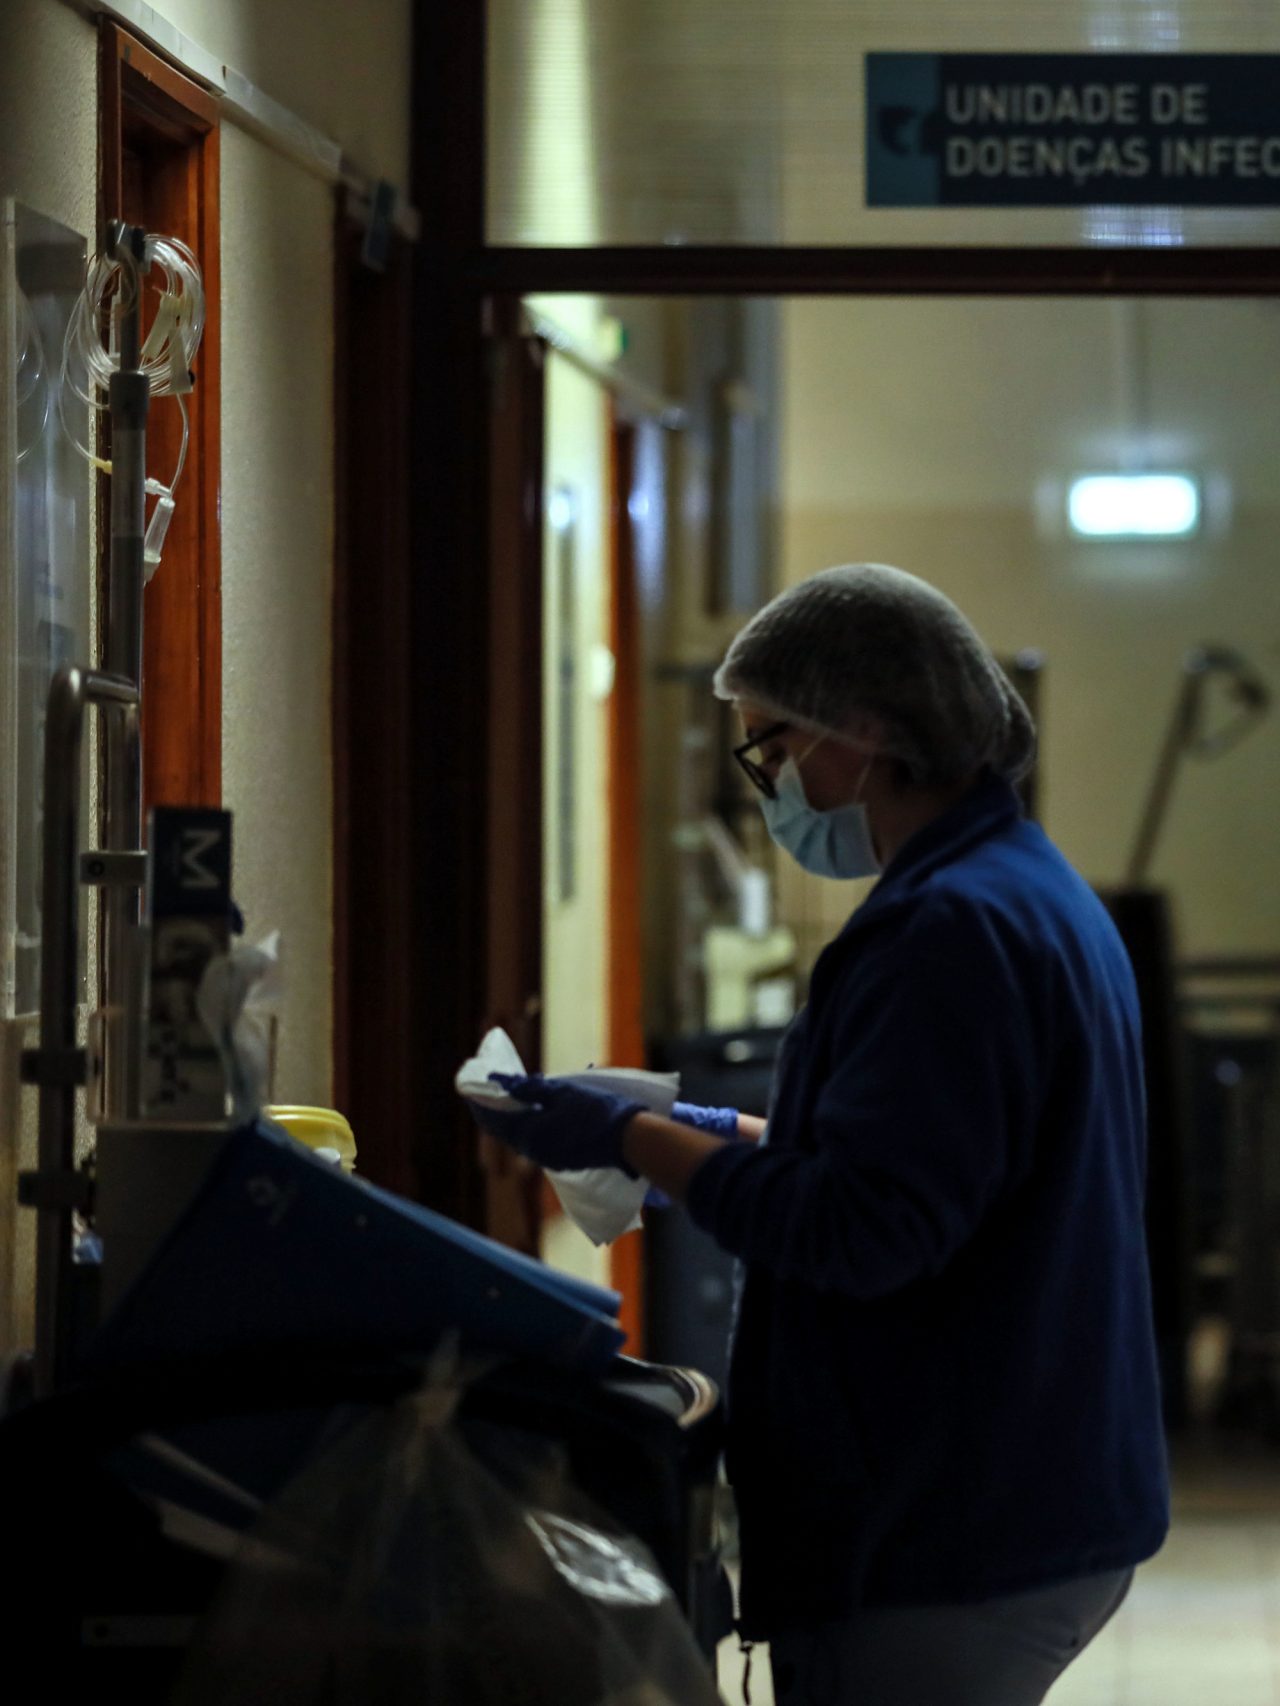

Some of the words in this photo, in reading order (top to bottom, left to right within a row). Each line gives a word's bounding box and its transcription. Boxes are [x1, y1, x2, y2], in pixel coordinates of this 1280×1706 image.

[946, 83, 1139, 125] UNIDADE
[1151, 83, 1209, 125] DE
[946, 137, 1150, 186] DOENÇAS
[181, 828, 222, 890] M
